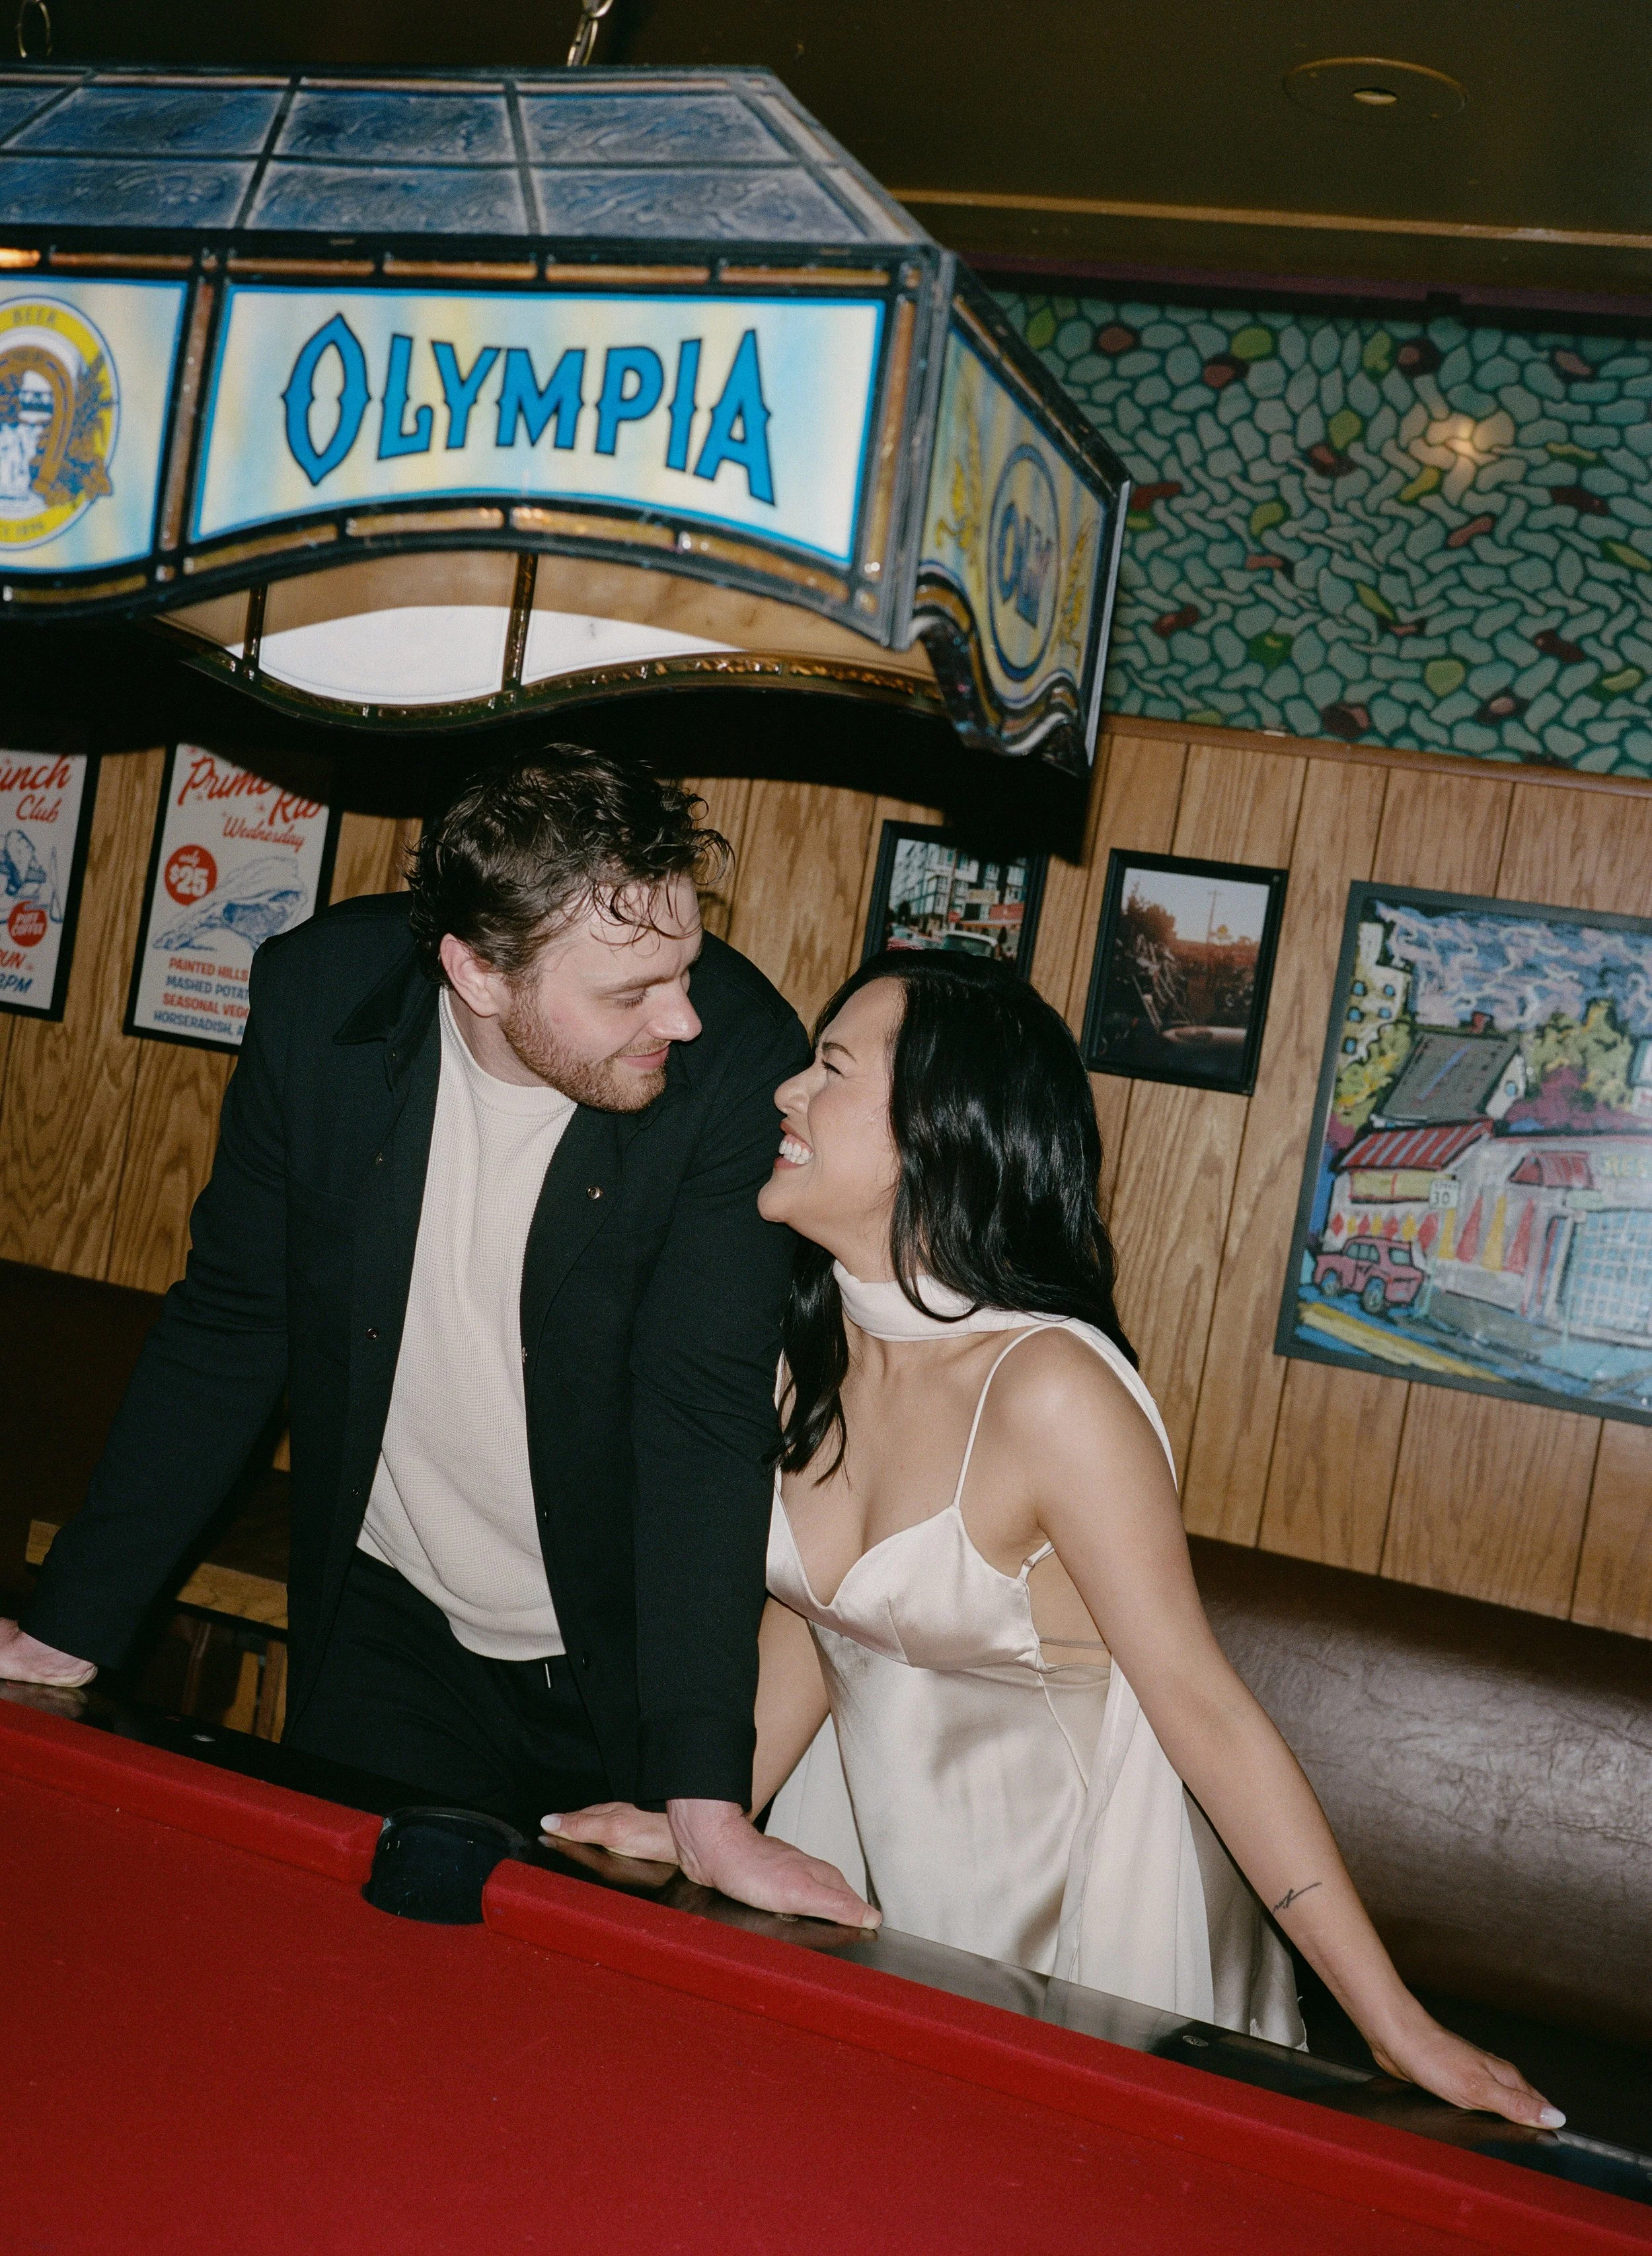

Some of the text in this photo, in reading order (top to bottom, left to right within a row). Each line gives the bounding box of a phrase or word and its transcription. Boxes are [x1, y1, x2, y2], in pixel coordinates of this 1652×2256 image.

[280, 312, 776, 507] OLYMPIA
[16, 794, 62, 823] Club
[222, 817, 305, 853] Wednesday
[169, 864, 208, 897] $25
[169, 957, 215, 976] PAINTED
[166, 975, 212, 994] MASHED
[163, 993, 219, 1015] SEASONAL
